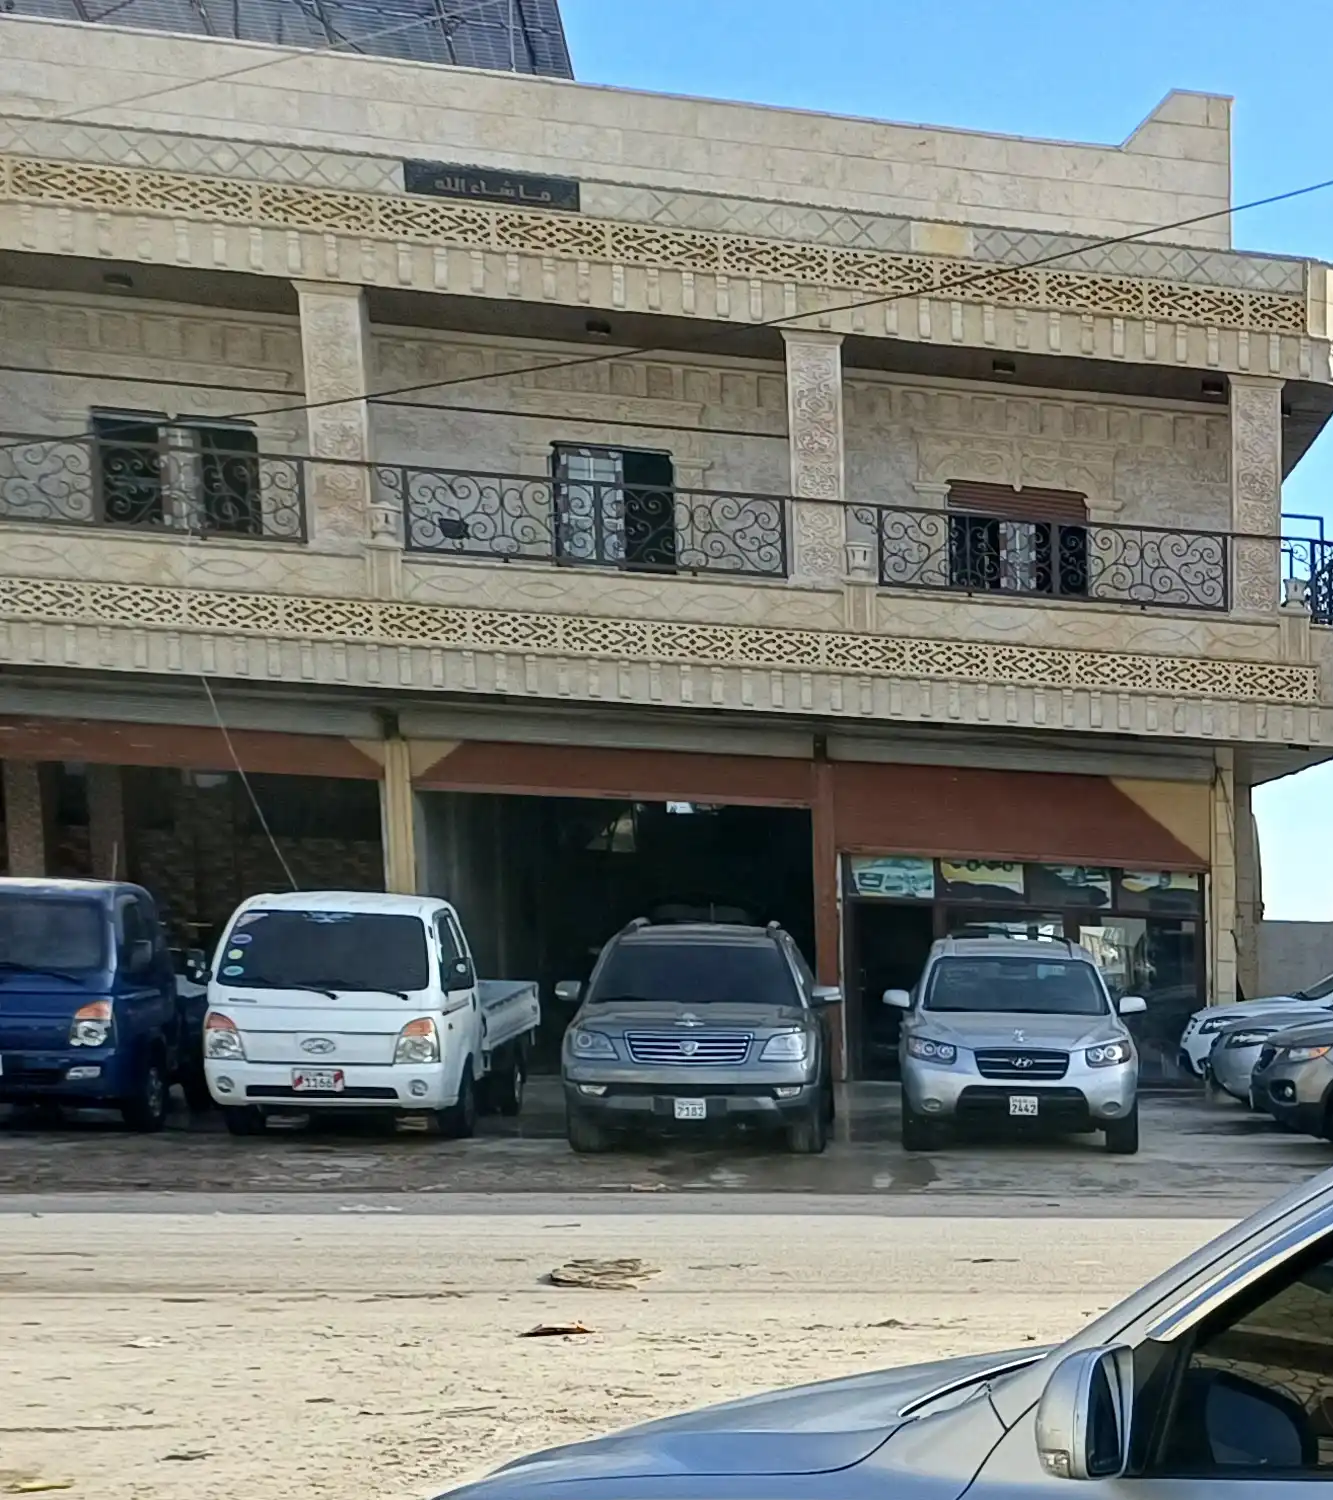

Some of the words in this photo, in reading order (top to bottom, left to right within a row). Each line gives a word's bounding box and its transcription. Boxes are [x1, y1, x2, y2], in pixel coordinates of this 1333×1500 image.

[434, 176, 466, 193] الله
[470, 179, 516, 197] شاء
[519, 184, 551, 202] ما
